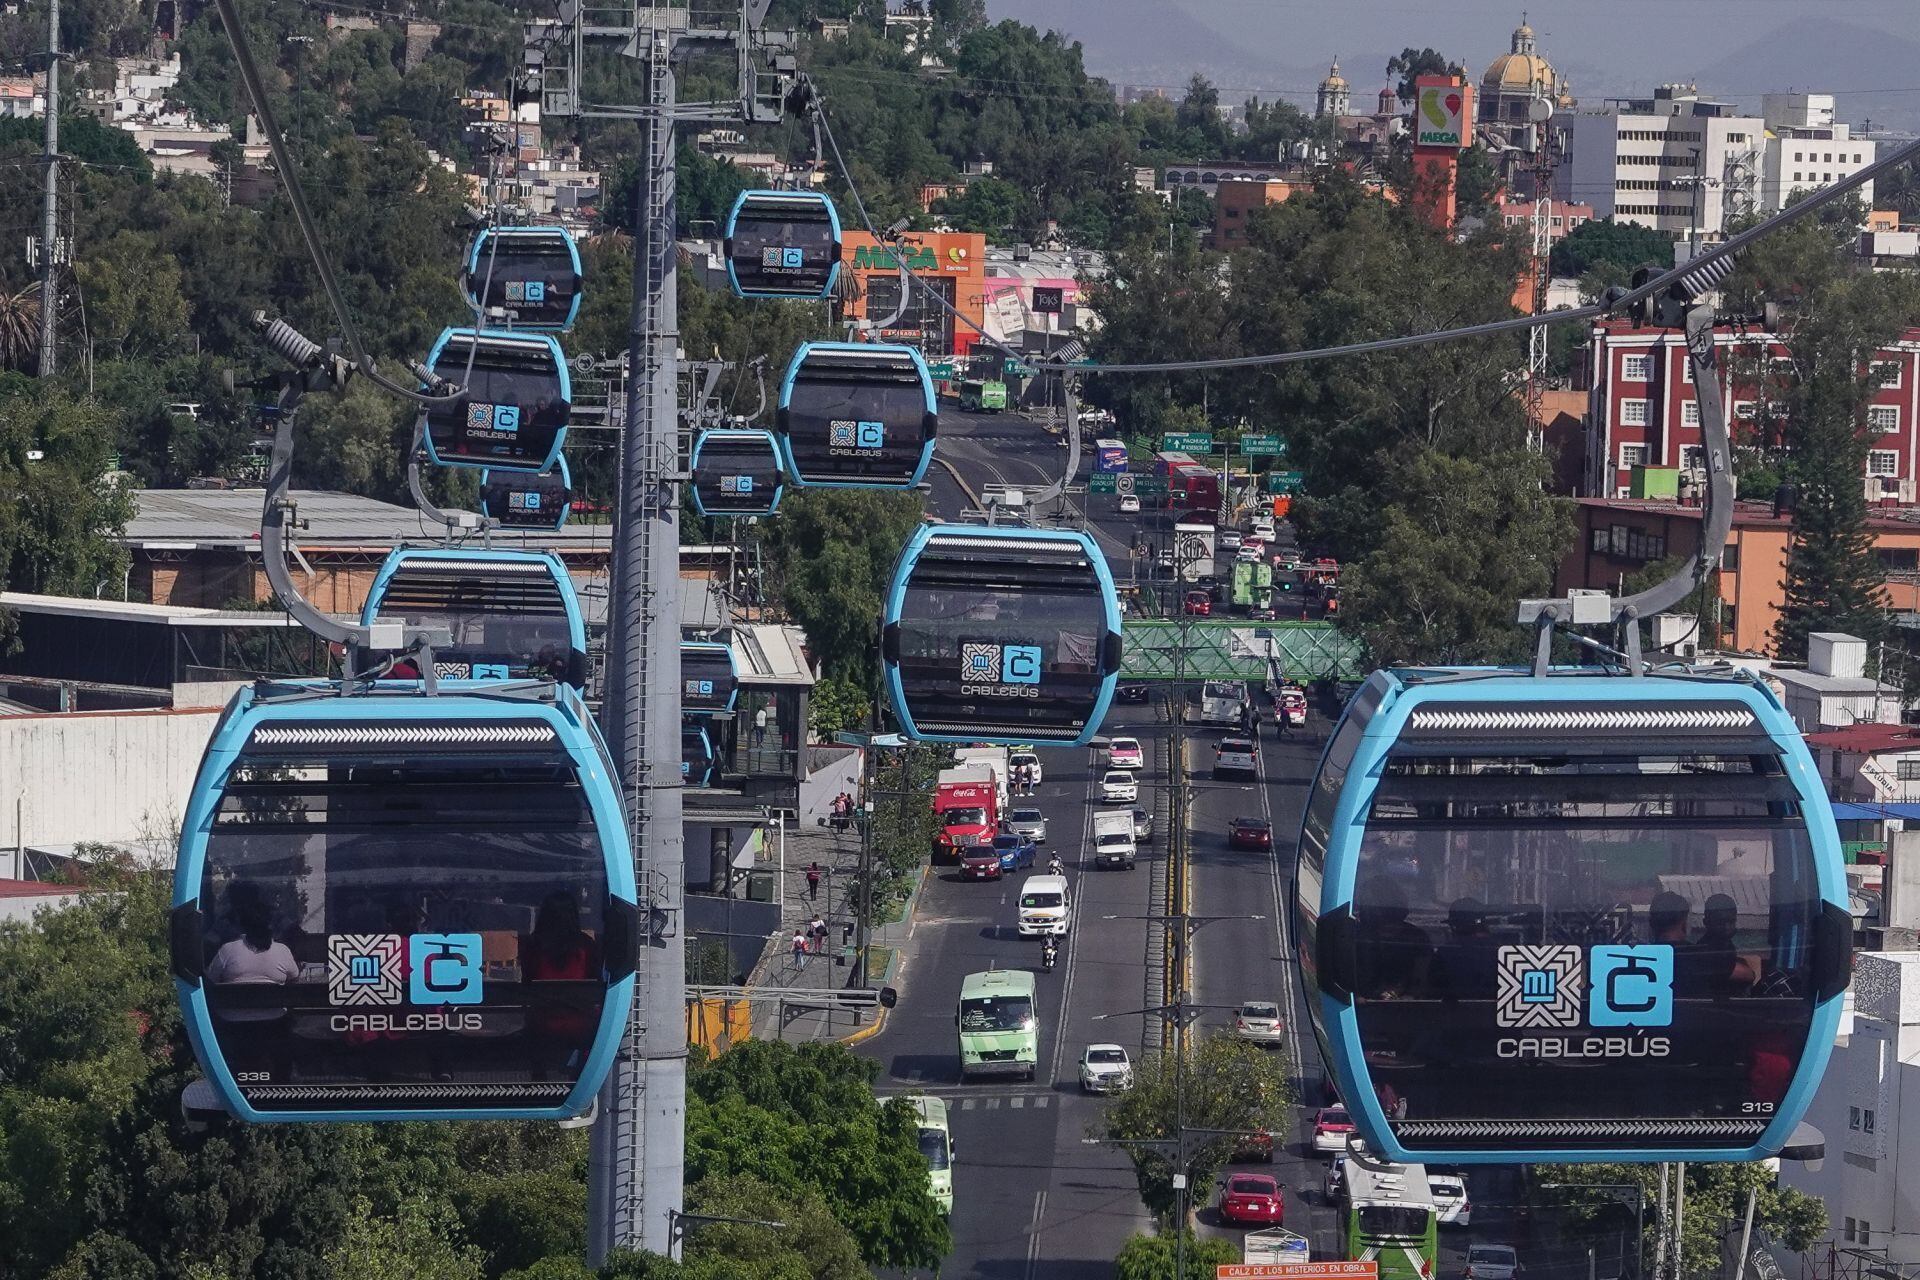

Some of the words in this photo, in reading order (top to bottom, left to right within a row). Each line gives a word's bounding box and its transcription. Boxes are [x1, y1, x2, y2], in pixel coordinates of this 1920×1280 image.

[1420, 132, 1460, 143] MEGA
[330, 1007, 483, 1032] CABLEBÚS
[1496, 1029, 1671, 1058] CABLEBÚS
[237, 1071, 270, 1081] 338
[1742, 1102, 1774, 1113] 313
[1229, 1267, 1250, 1276] CALZ
[1253, 1266, 1264, 1275] DE
[1267, 1266, 1283, 1275] LOS
[1286, 1264, 1326, 1274] MISTERIOS
[1329, 1264, 1341, 1273] EN
[1343, 1264, 1366, 1273] OBRA
